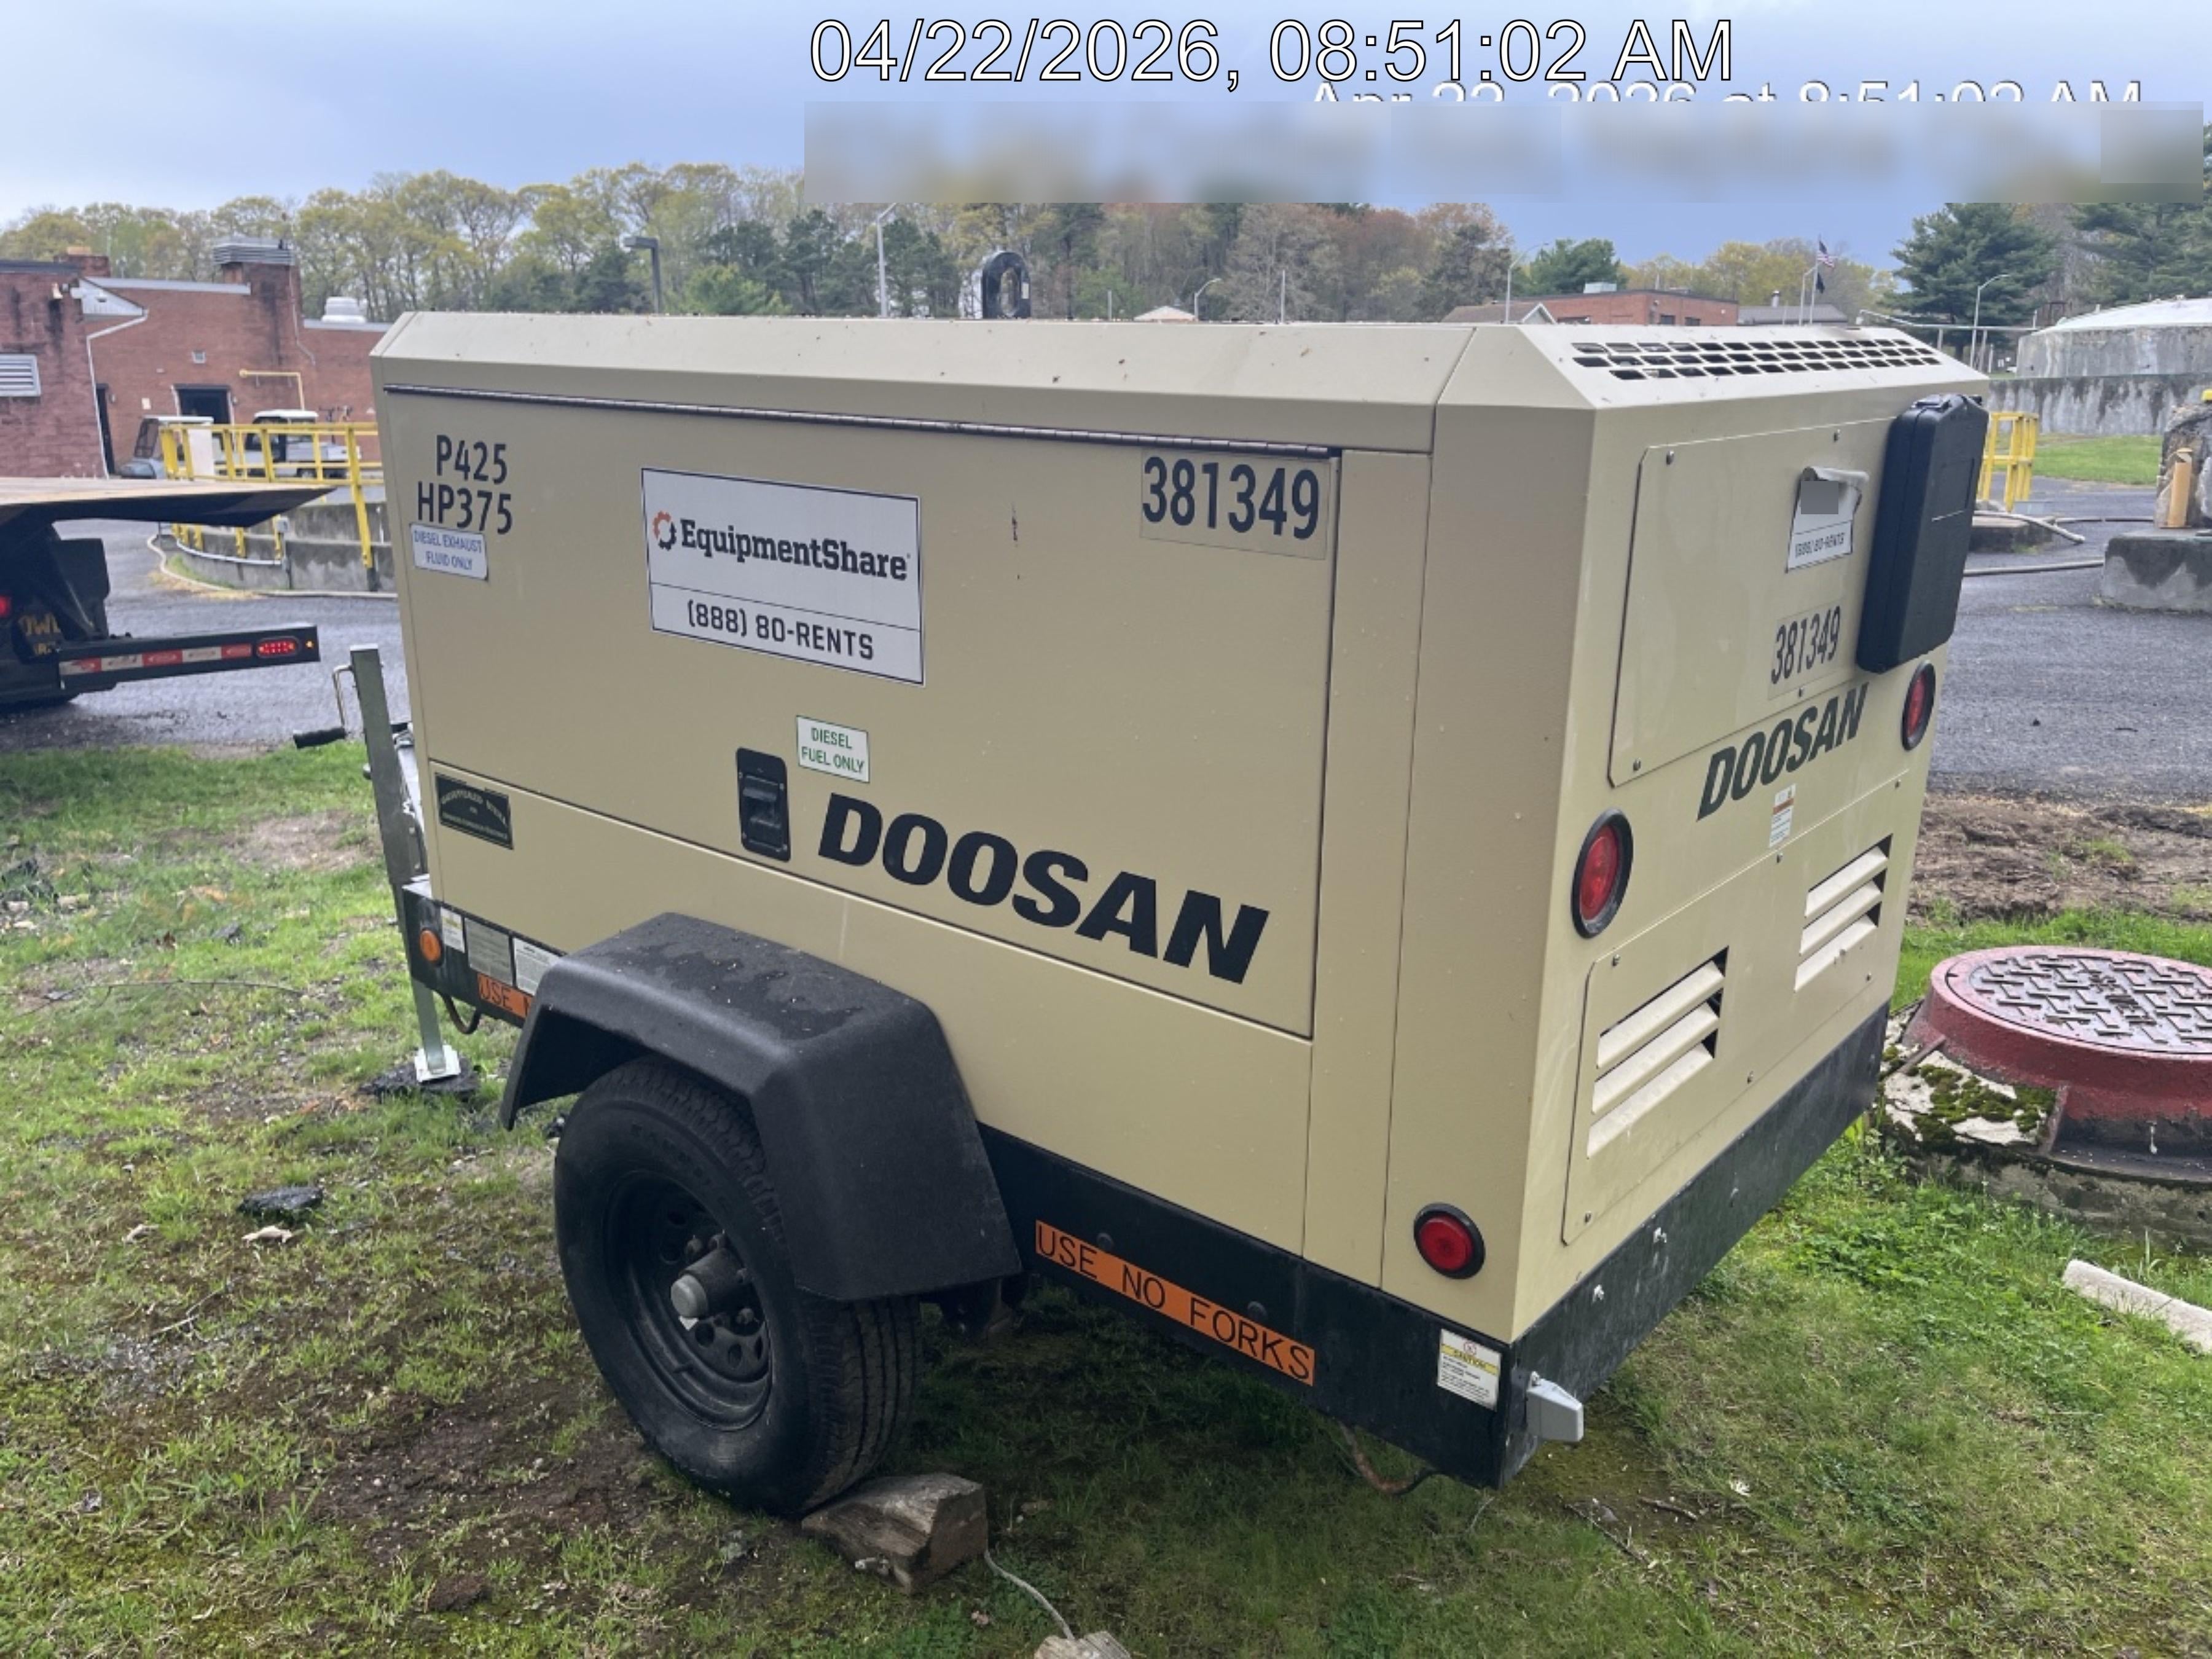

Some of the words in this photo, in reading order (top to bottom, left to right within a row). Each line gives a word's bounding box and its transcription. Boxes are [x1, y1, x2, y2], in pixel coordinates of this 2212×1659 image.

[436, 434, 508, 484] P425
[418, 480, 512, 535] HP375
[1142, 456, 1319, 539] 381349
[414, 530, 441, 546] DIESEL
[442, 534, 482, 553] EXHAUST
[425, 551, 450, 567] FLUID
[451, 555, 473, 570] ONLY
[680, 519, 908, 581] EquipmentShare
[687, 599, 747, 637] (888)
[756, 614, 874, 660] 80-RENTS
[1771, 605, 1840, 684] 381349
[801, 746, 831, 766] FUEL
[833, 754, 865, 774] ONLY
[810, 728, 852, 749] DIESEL
[1696, 681, 1870, 822] DOOSAN
[818, 792, 1270, 985] DOOSAN
[479, 973, 514, 1011] USE
[1038, 1224, 1098, 1280] USE
[1121, 1263, 1166, 1310] NO
[1189, 1296, 1311, 1381] FORKS
